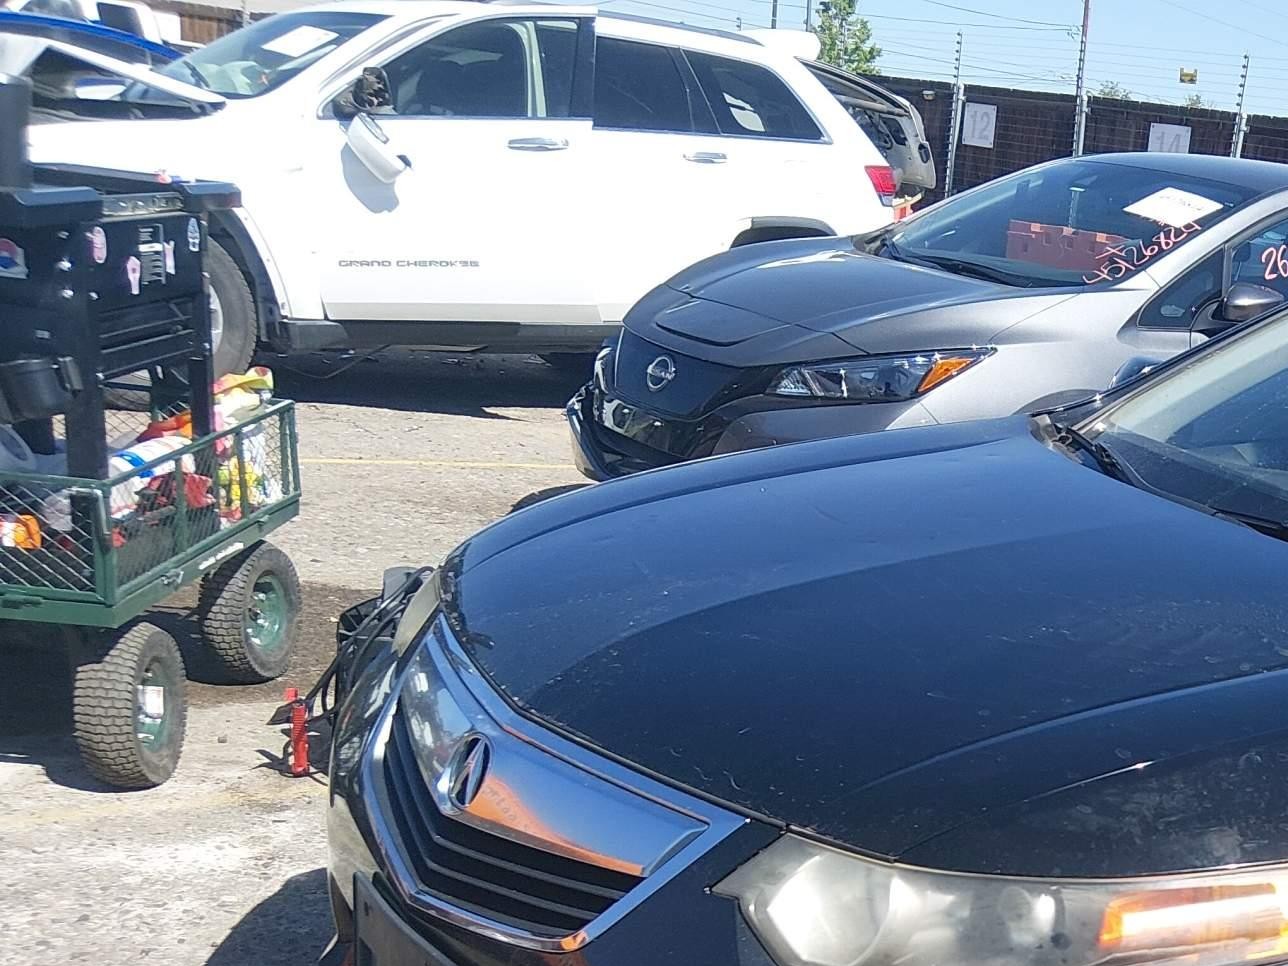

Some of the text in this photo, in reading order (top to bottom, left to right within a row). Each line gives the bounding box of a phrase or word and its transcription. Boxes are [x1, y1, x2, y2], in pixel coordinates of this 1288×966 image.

[969, 110, 990, 140] 12
[338, 259, 481, 268] GRAND CHEROKEE
[1083, 221, 1202, 284] 45126824
